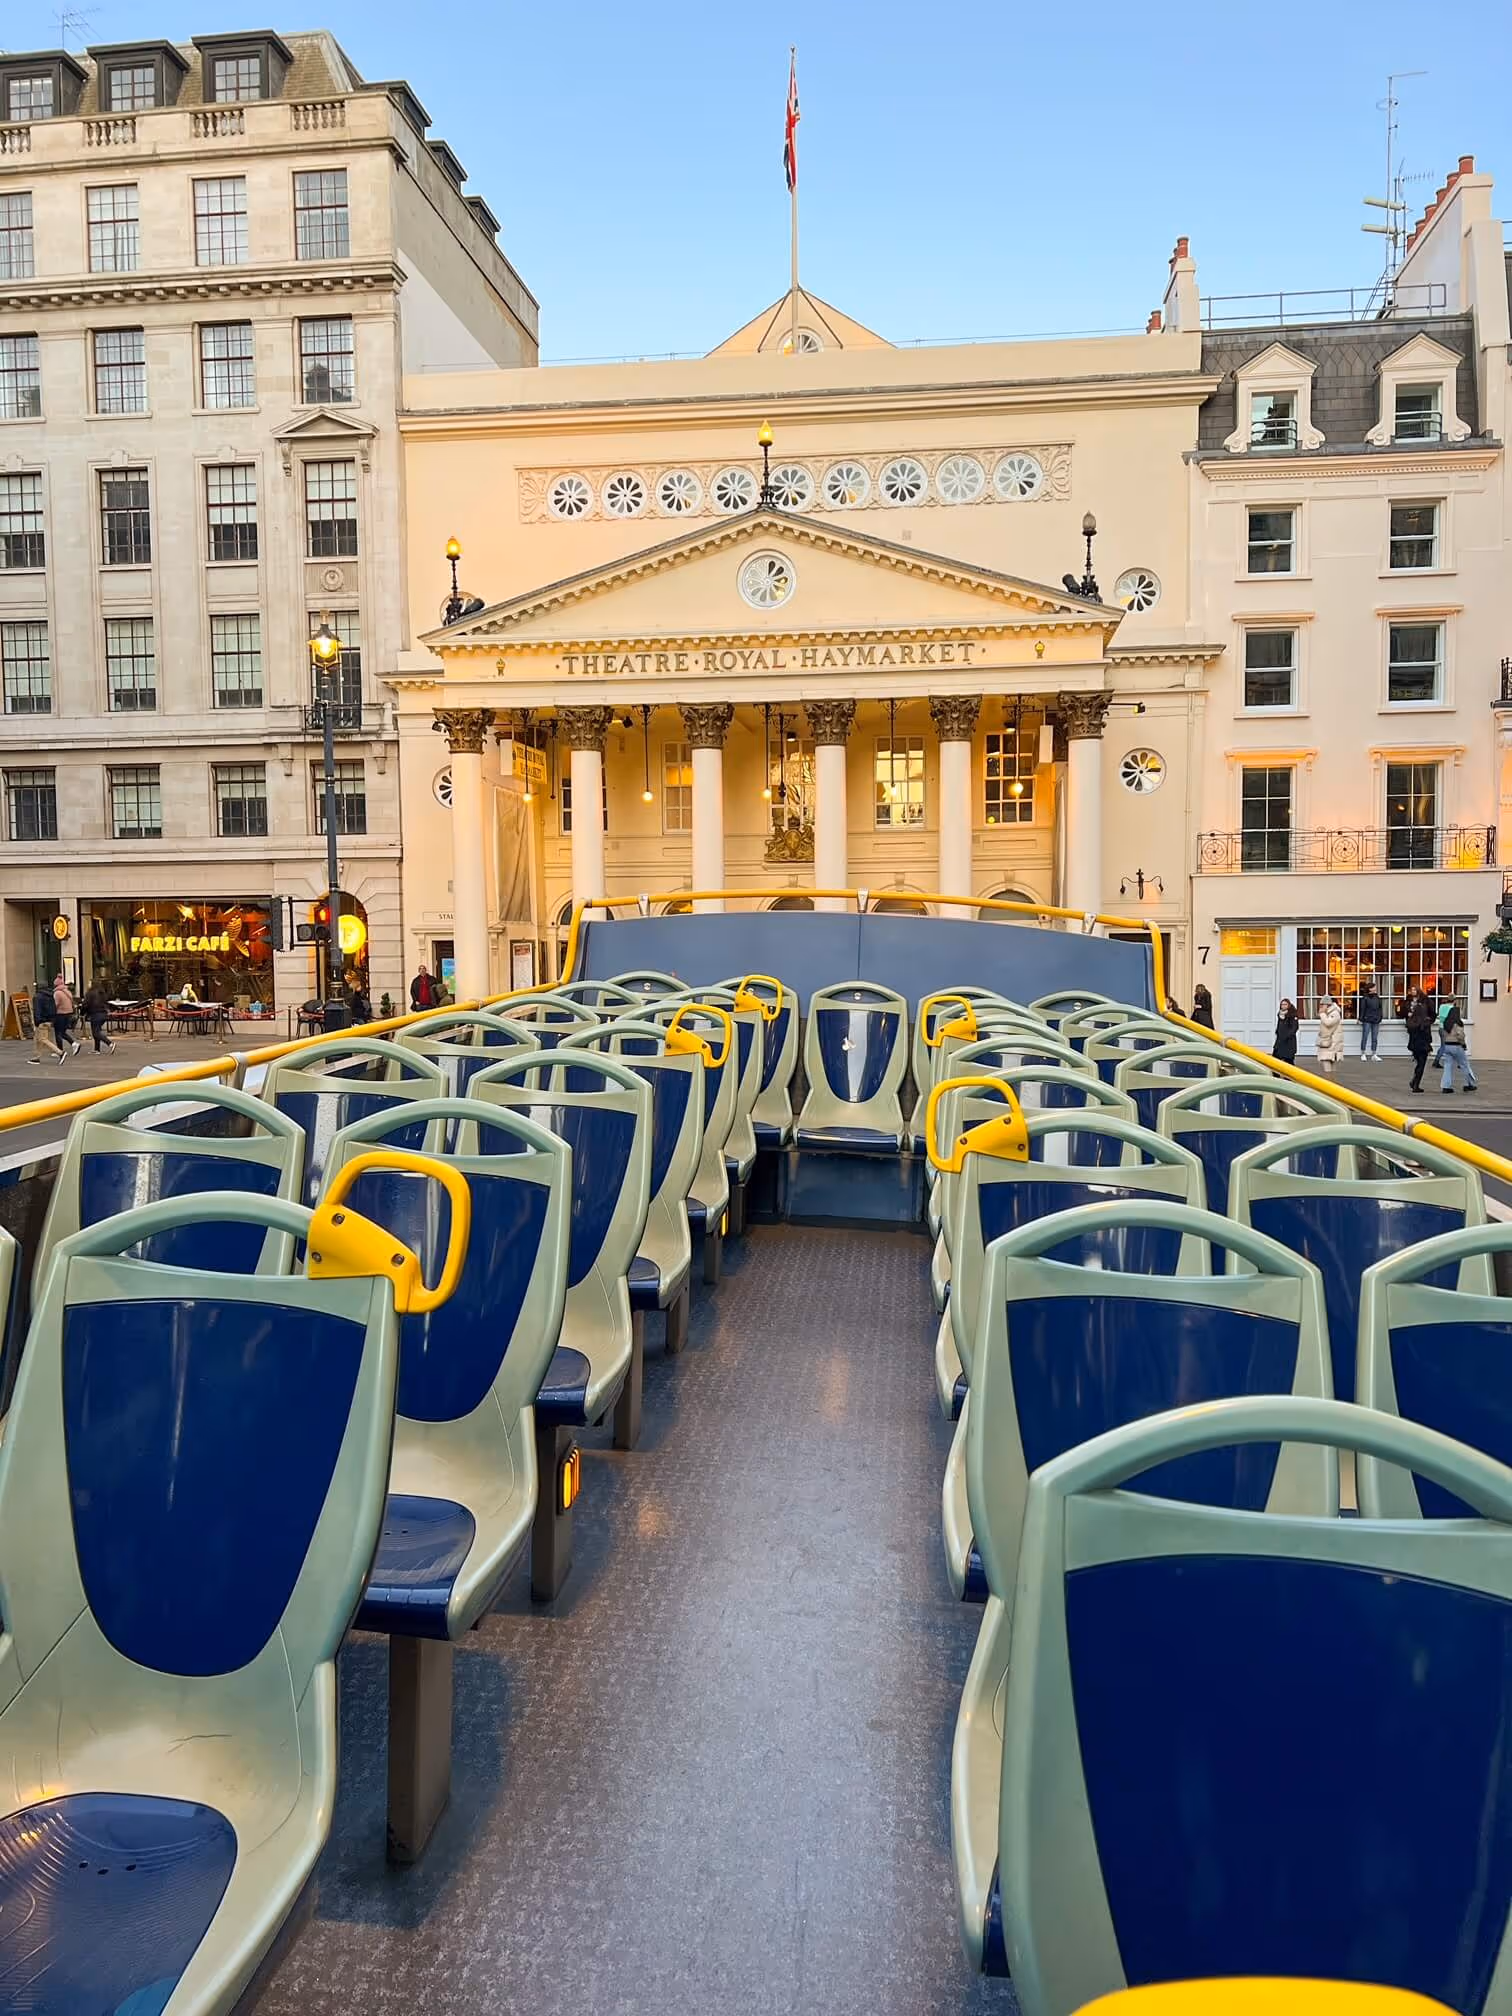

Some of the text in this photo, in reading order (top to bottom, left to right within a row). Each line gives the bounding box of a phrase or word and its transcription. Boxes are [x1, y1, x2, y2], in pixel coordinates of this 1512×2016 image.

[562, 643, 975, 675] THEATRE ROYAL HAYMARKET
[131, 931, 230, 952] FARZI CAFÉ
[1198, 946, 1210, 965] 7
